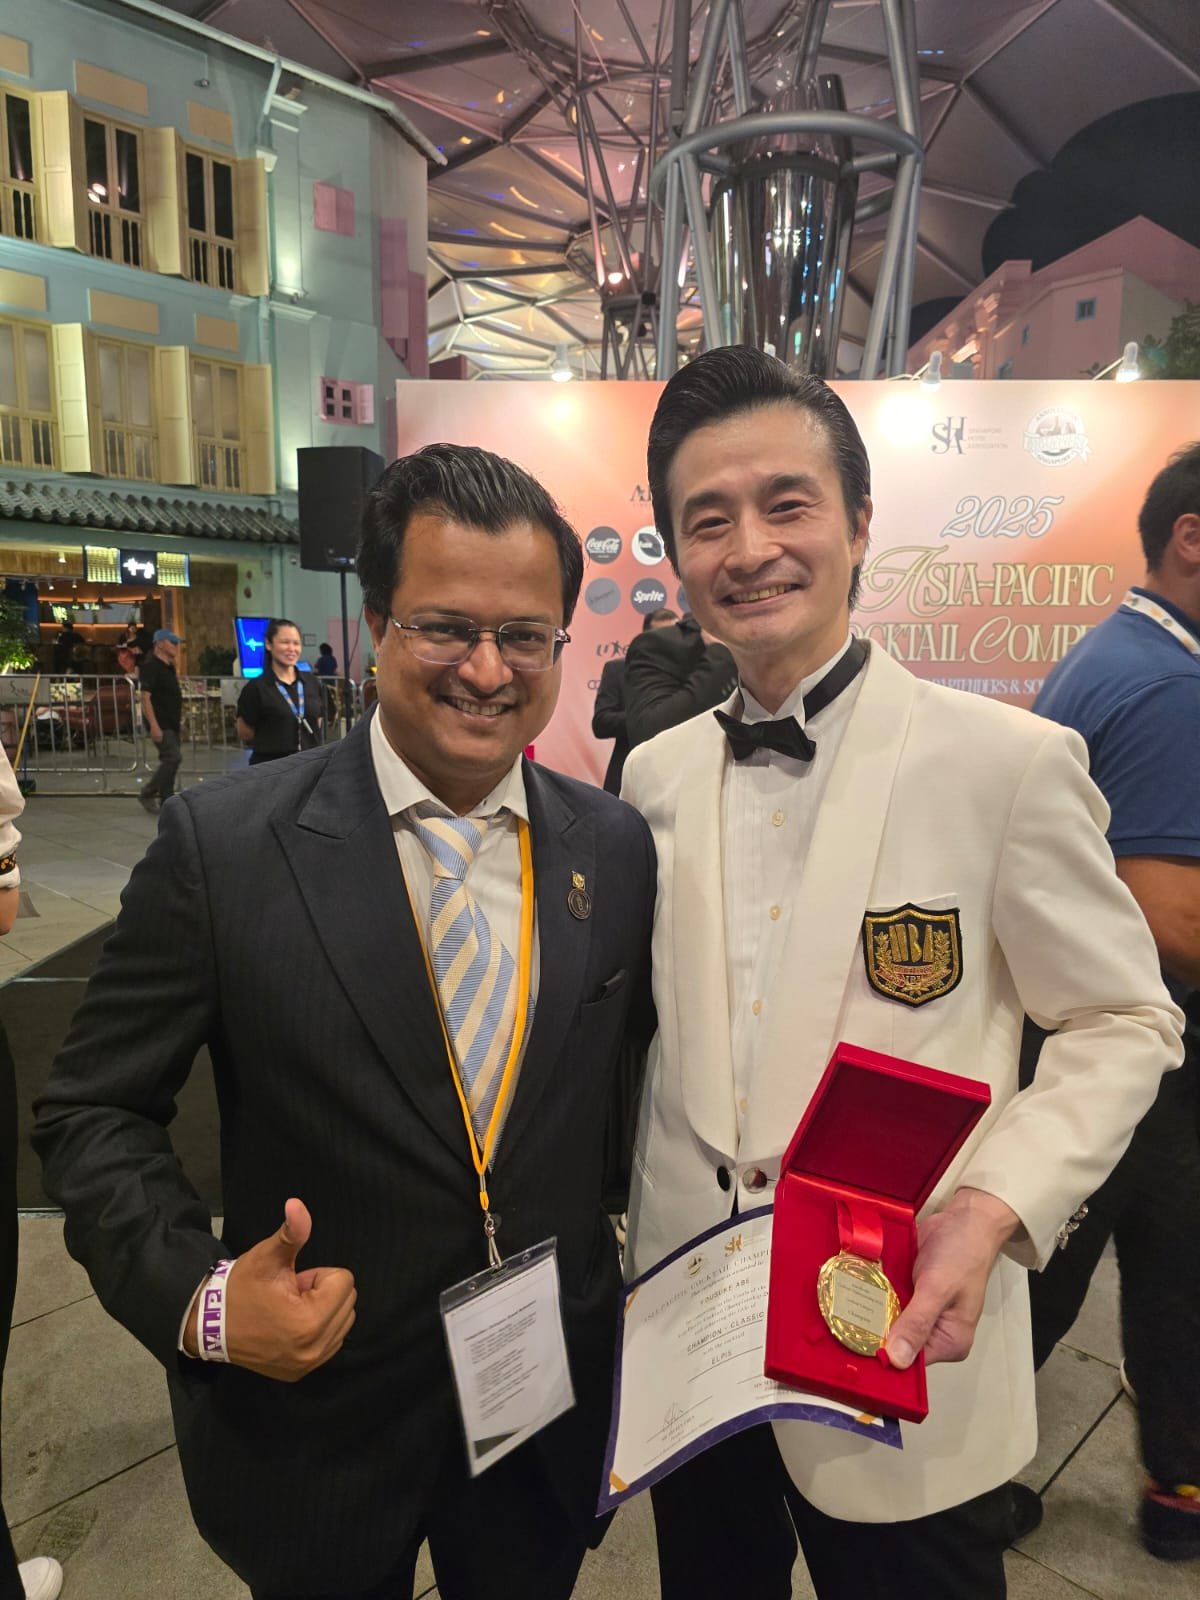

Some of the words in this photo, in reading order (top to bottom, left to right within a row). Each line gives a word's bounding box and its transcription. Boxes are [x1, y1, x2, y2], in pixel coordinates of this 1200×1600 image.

[940, 496, 1064, 538] 2025
[634, 590, 665, 604] Sprite
[849, 623, 965, 662] CKTAIL
[969, 616, 1097, 663] COMP
[730, 1311, 765, 1329] CLASSIC
[711, 1350, 732, 1365] ELPIS
